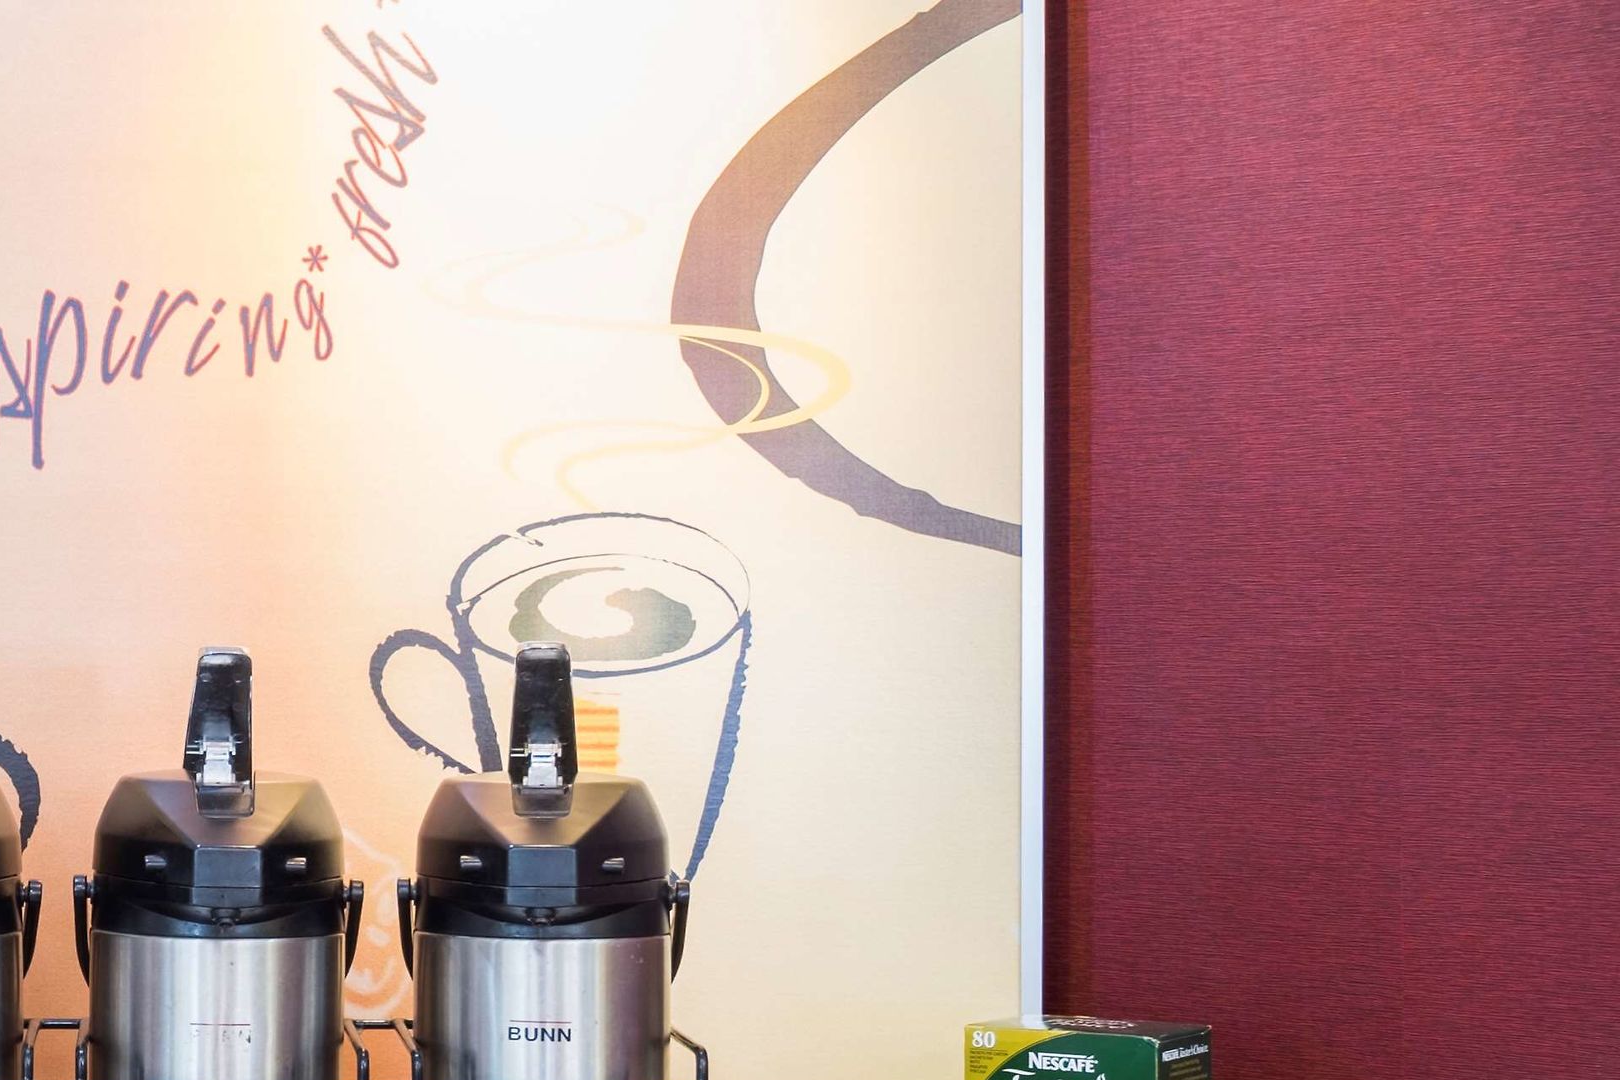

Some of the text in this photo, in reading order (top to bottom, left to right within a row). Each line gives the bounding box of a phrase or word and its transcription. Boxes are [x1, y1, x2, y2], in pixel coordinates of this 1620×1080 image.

[508, 1026, 572, 1042] BUNN
[972, 1031, 996, 1048] 80
[1028, 1051, 1096, 1074] NESCAFÉ
